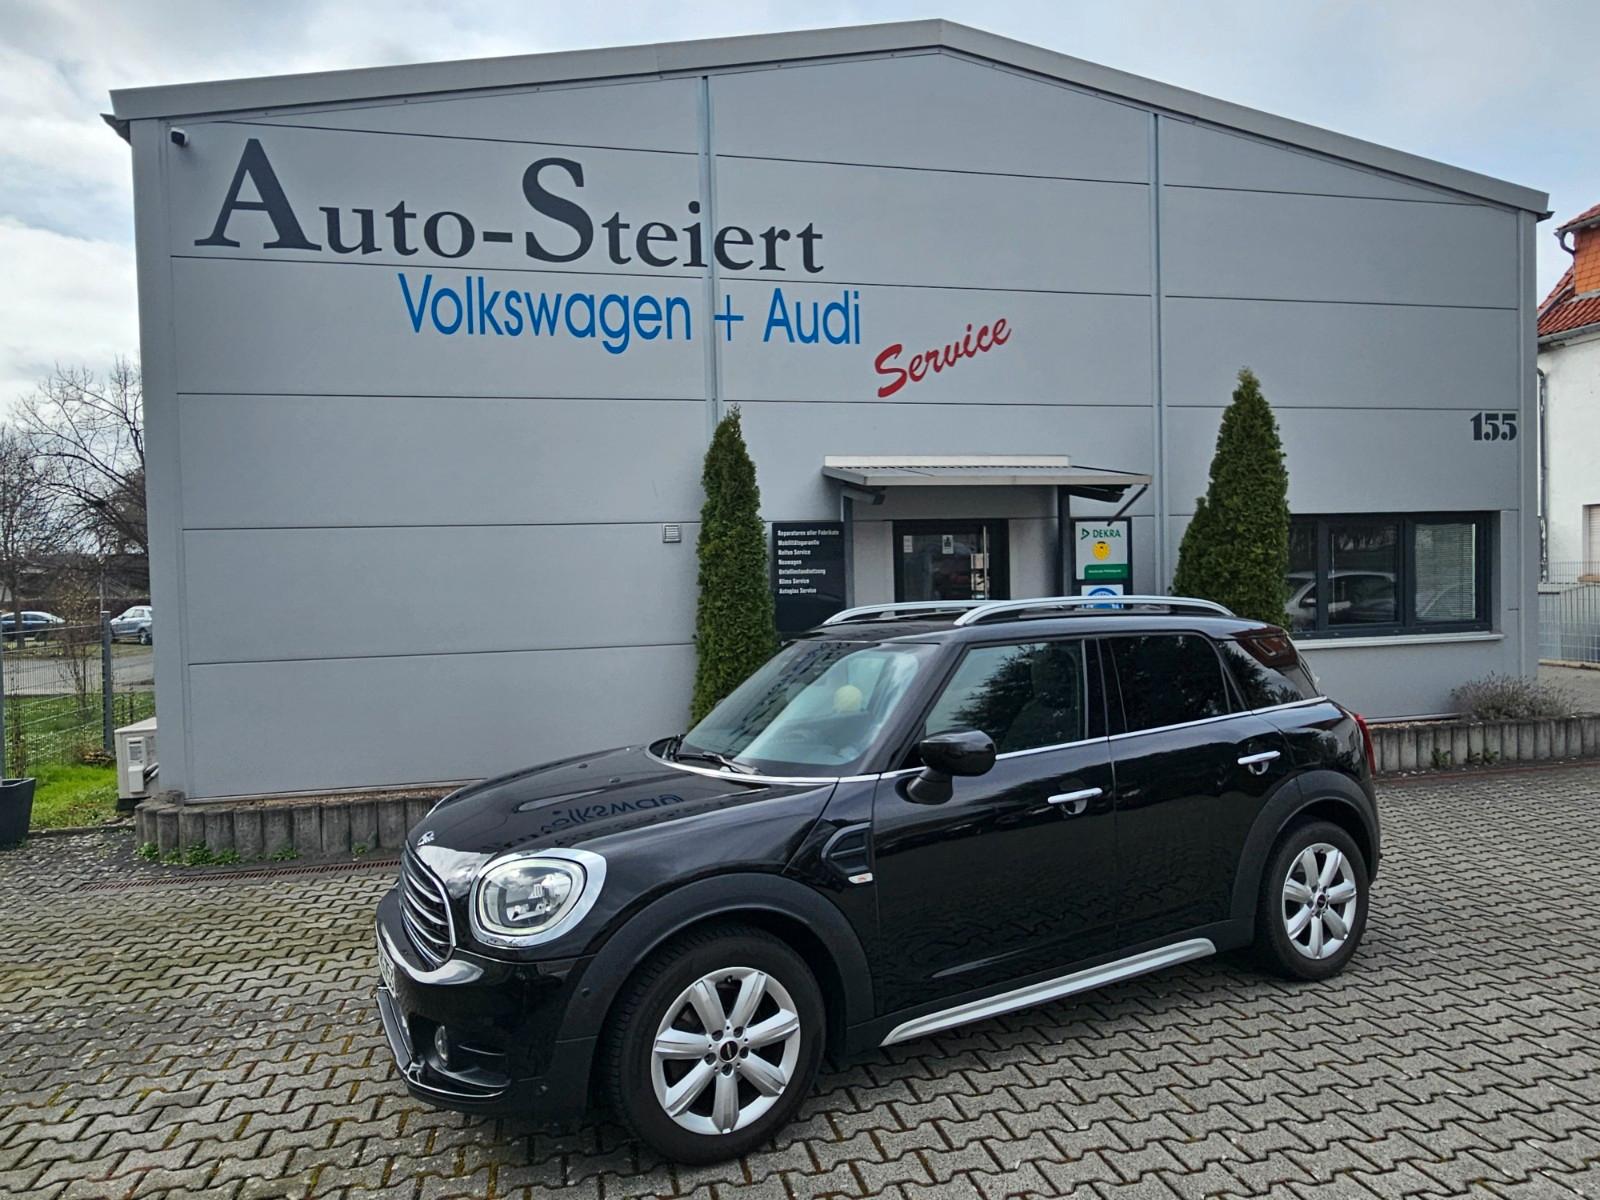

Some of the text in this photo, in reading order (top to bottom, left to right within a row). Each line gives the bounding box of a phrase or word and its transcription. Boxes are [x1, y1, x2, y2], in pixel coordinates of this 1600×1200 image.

[194, 138, 824, 274] Auto-Steiert
[397, 273, 692, 354] Volkswagen
[763, 287, 861, 345] Audi
[874, 318, 1012, 398] Service
[1470, 412, 1517, 441] 155
[1092, 529, 1121, 538] DEKRA
